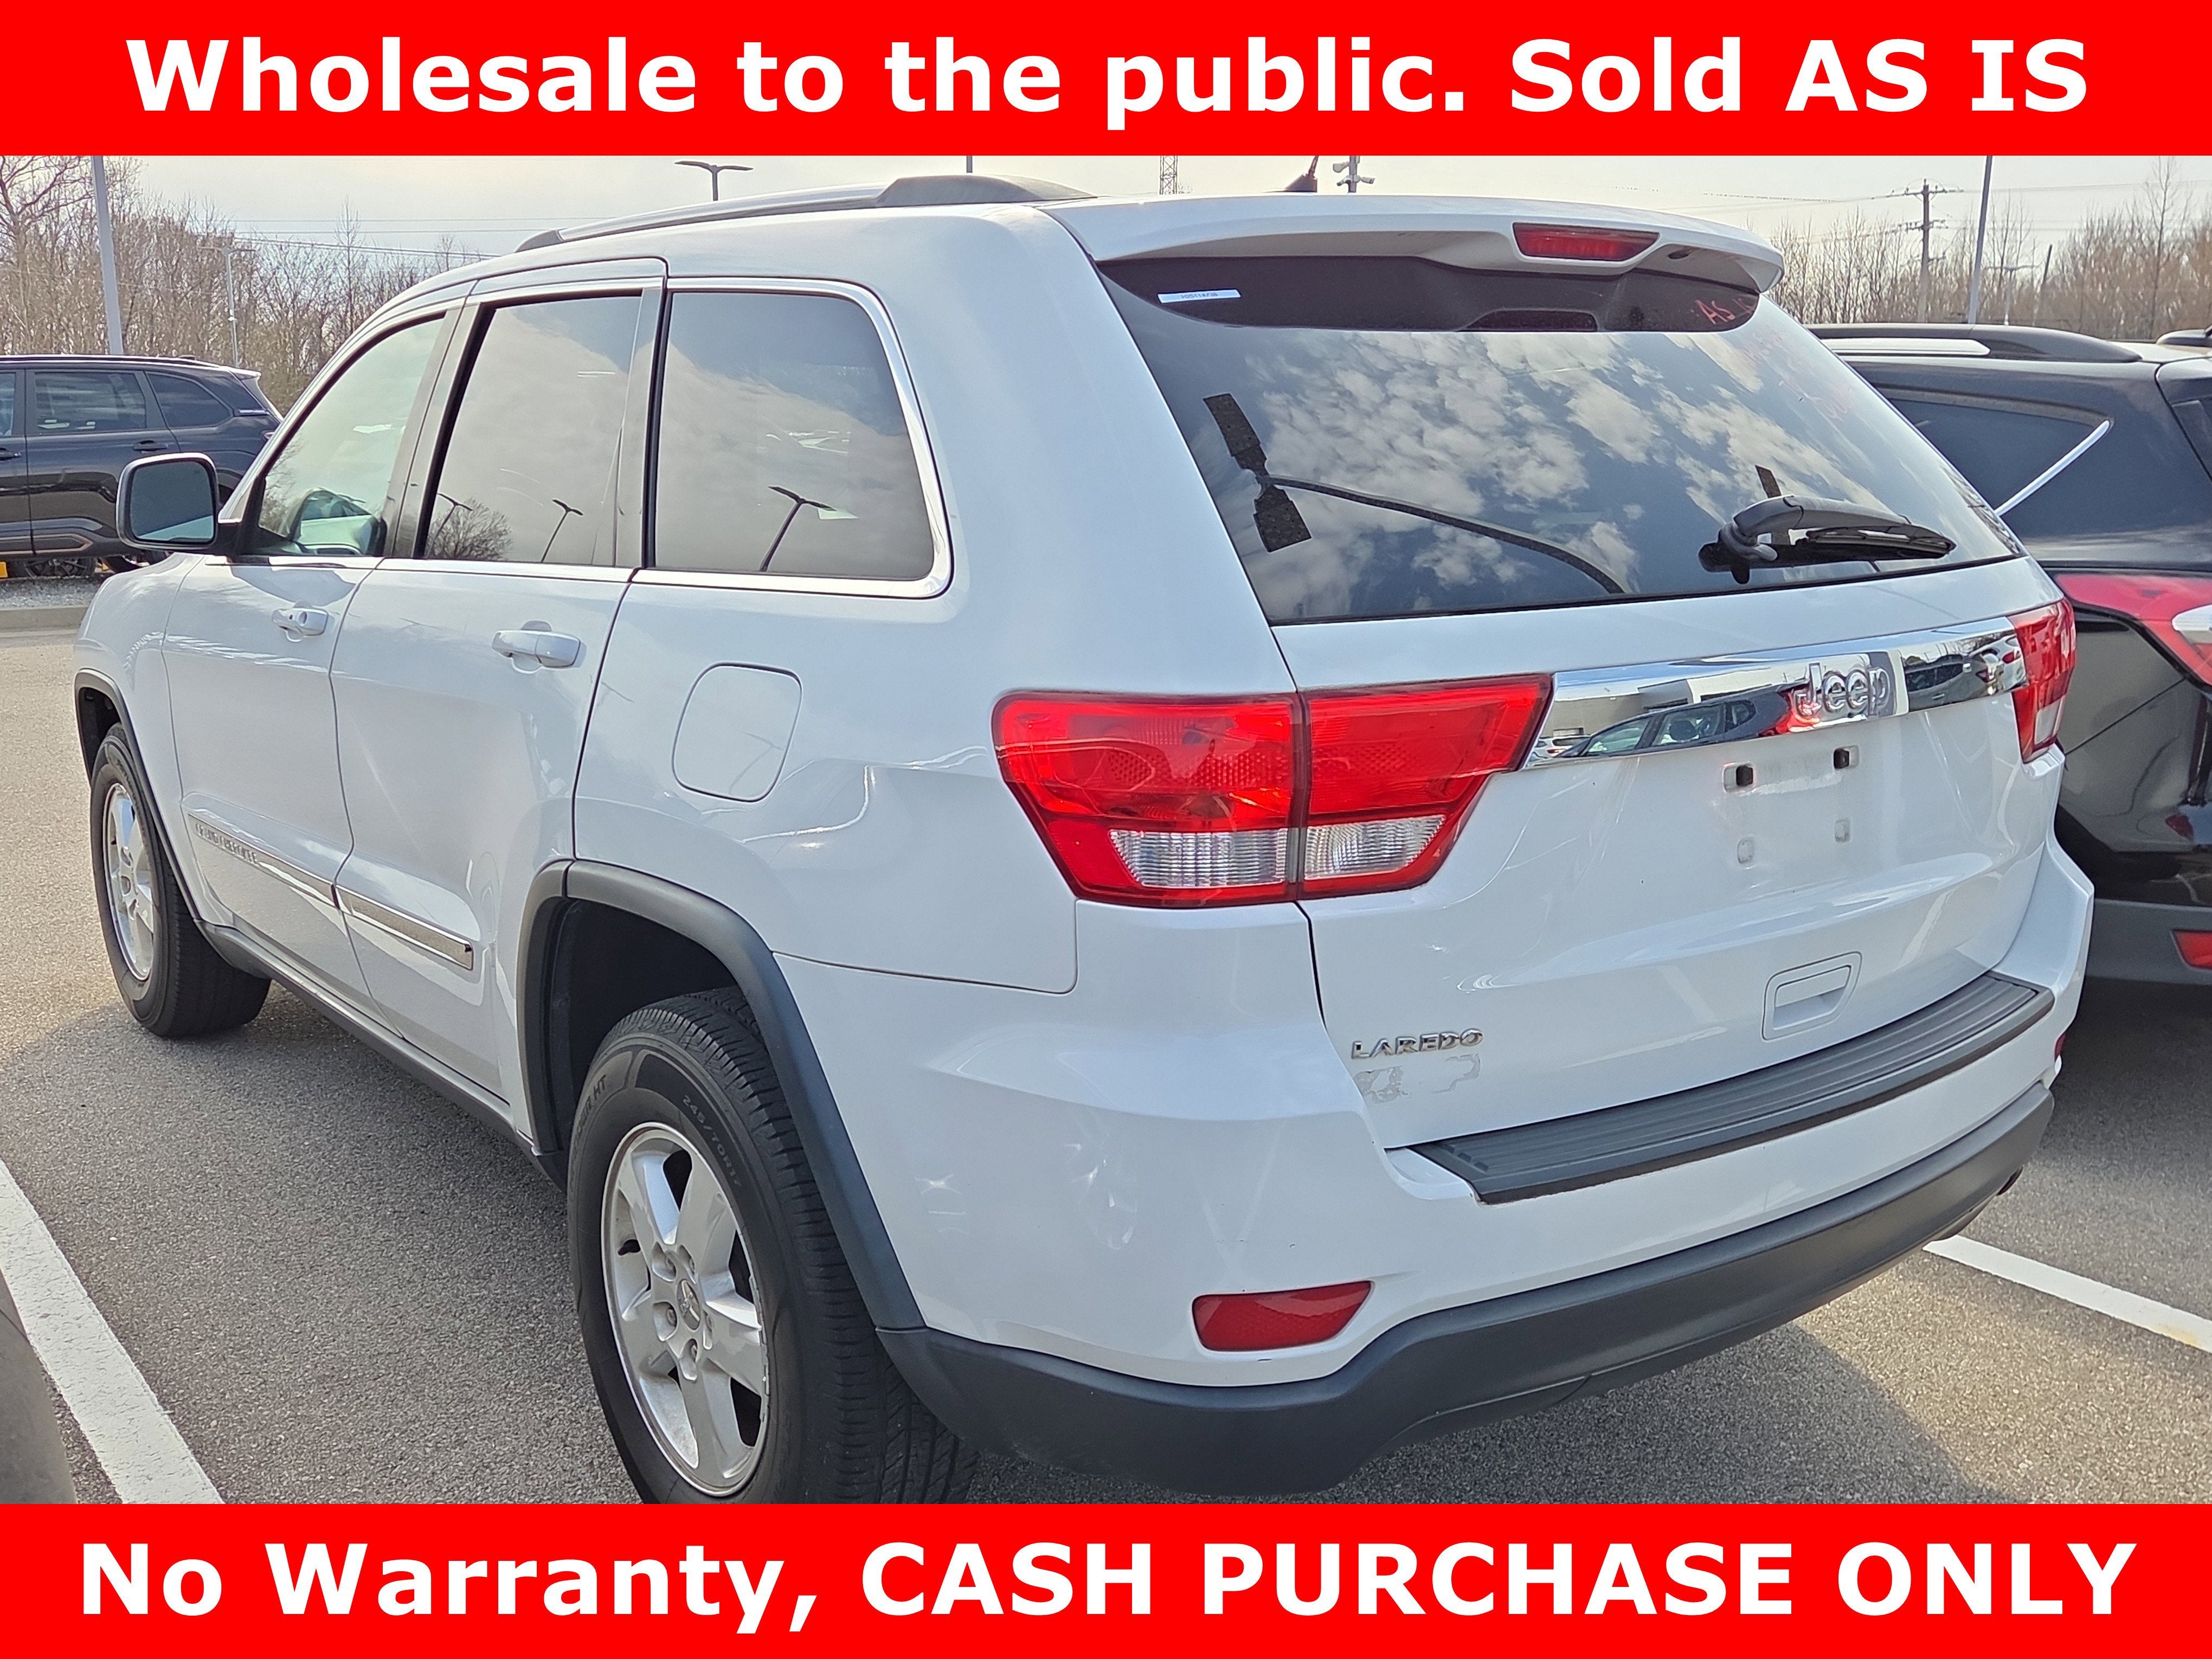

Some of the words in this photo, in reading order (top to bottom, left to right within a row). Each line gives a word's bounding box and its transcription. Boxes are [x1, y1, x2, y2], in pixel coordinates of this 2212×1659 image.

[1695, 300, 1735, 324] AS
[1793, 662, 1890, 718] Jeep
[1351, 1028, 1483, 1059] LAREDO
[682, 1095, 743, 1187] 245/70R17
